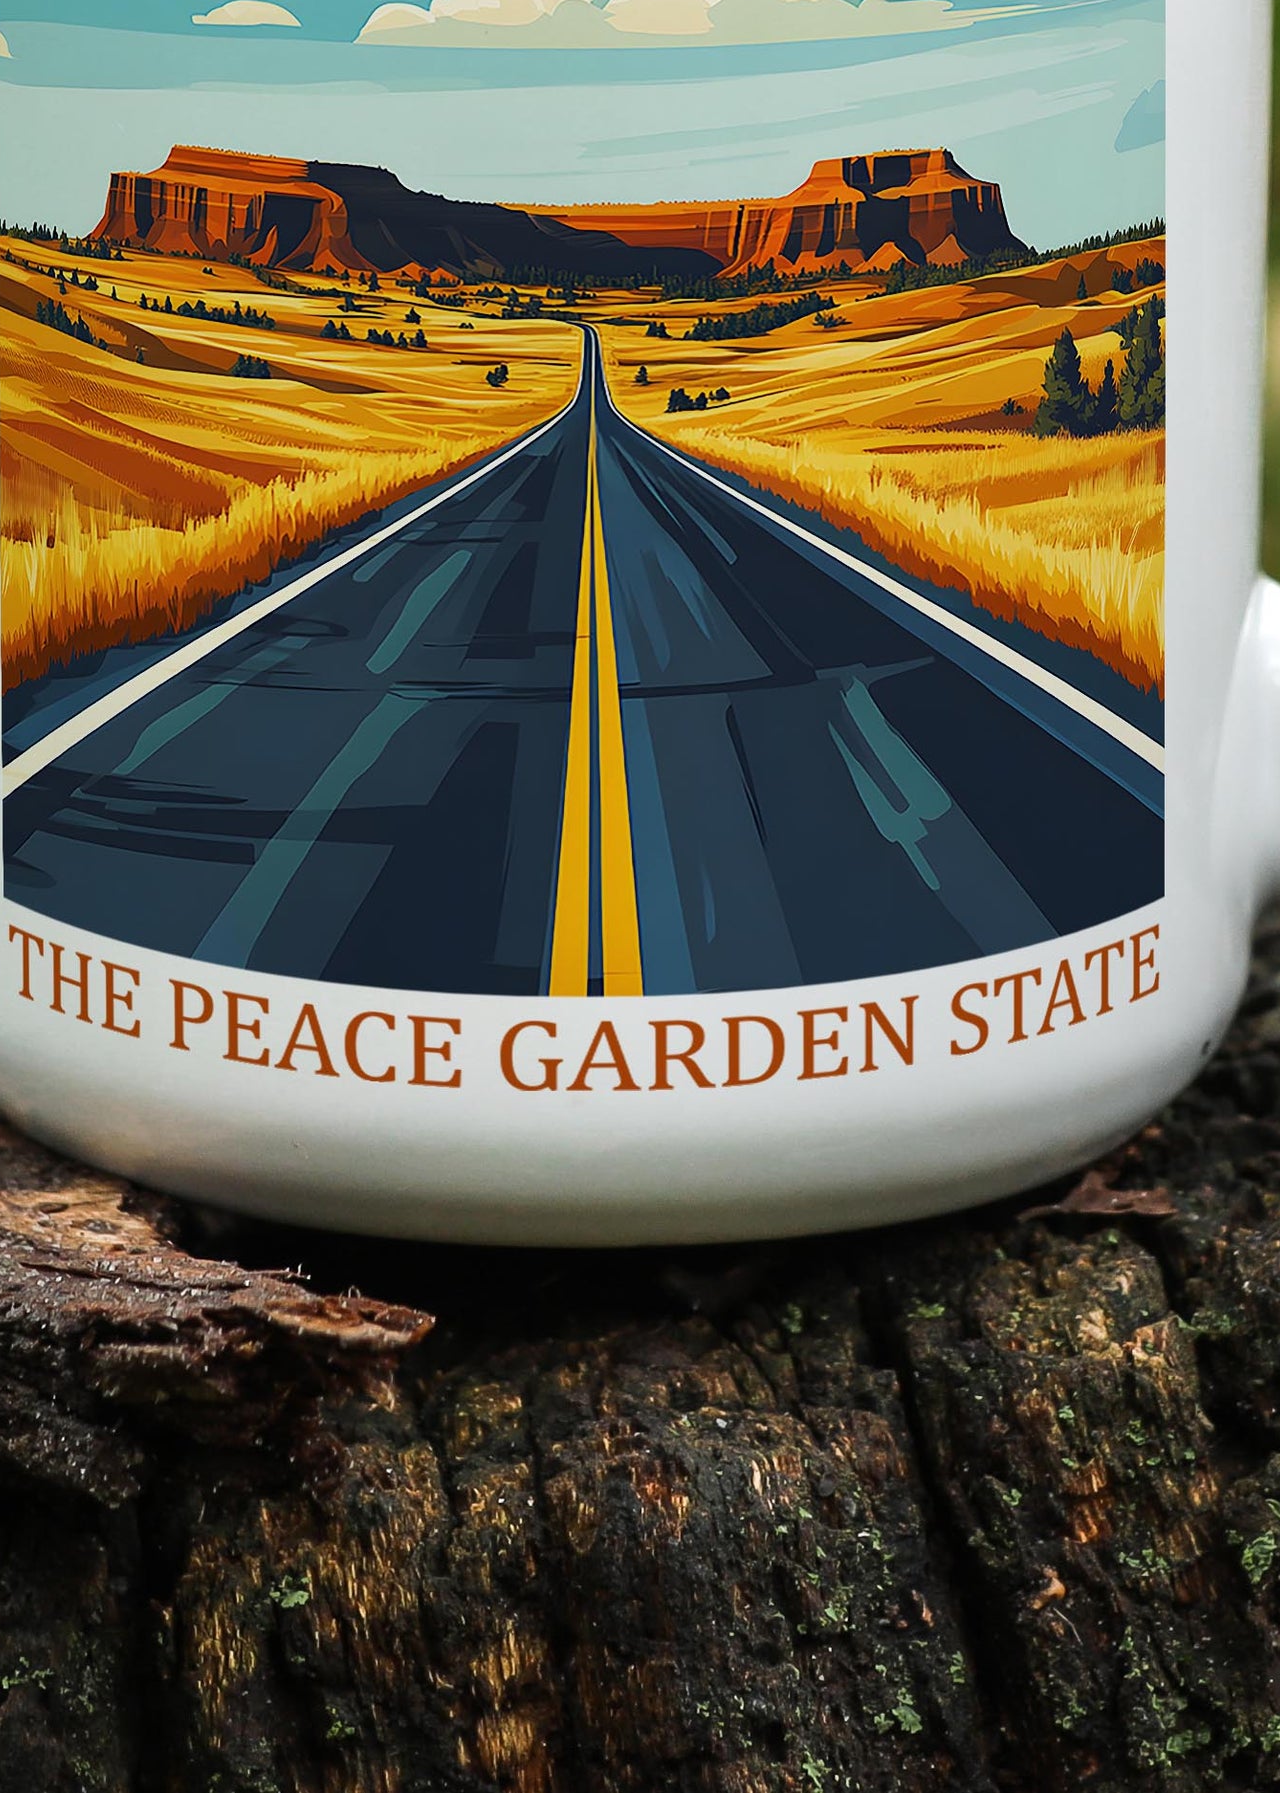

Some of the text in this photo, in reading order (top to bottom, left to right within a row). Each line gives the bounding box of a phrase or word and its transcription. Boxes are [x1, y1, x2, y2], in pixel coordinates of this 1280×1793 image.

[7, 923, 1162, 1093] THE PEACE GARDEN STATE
